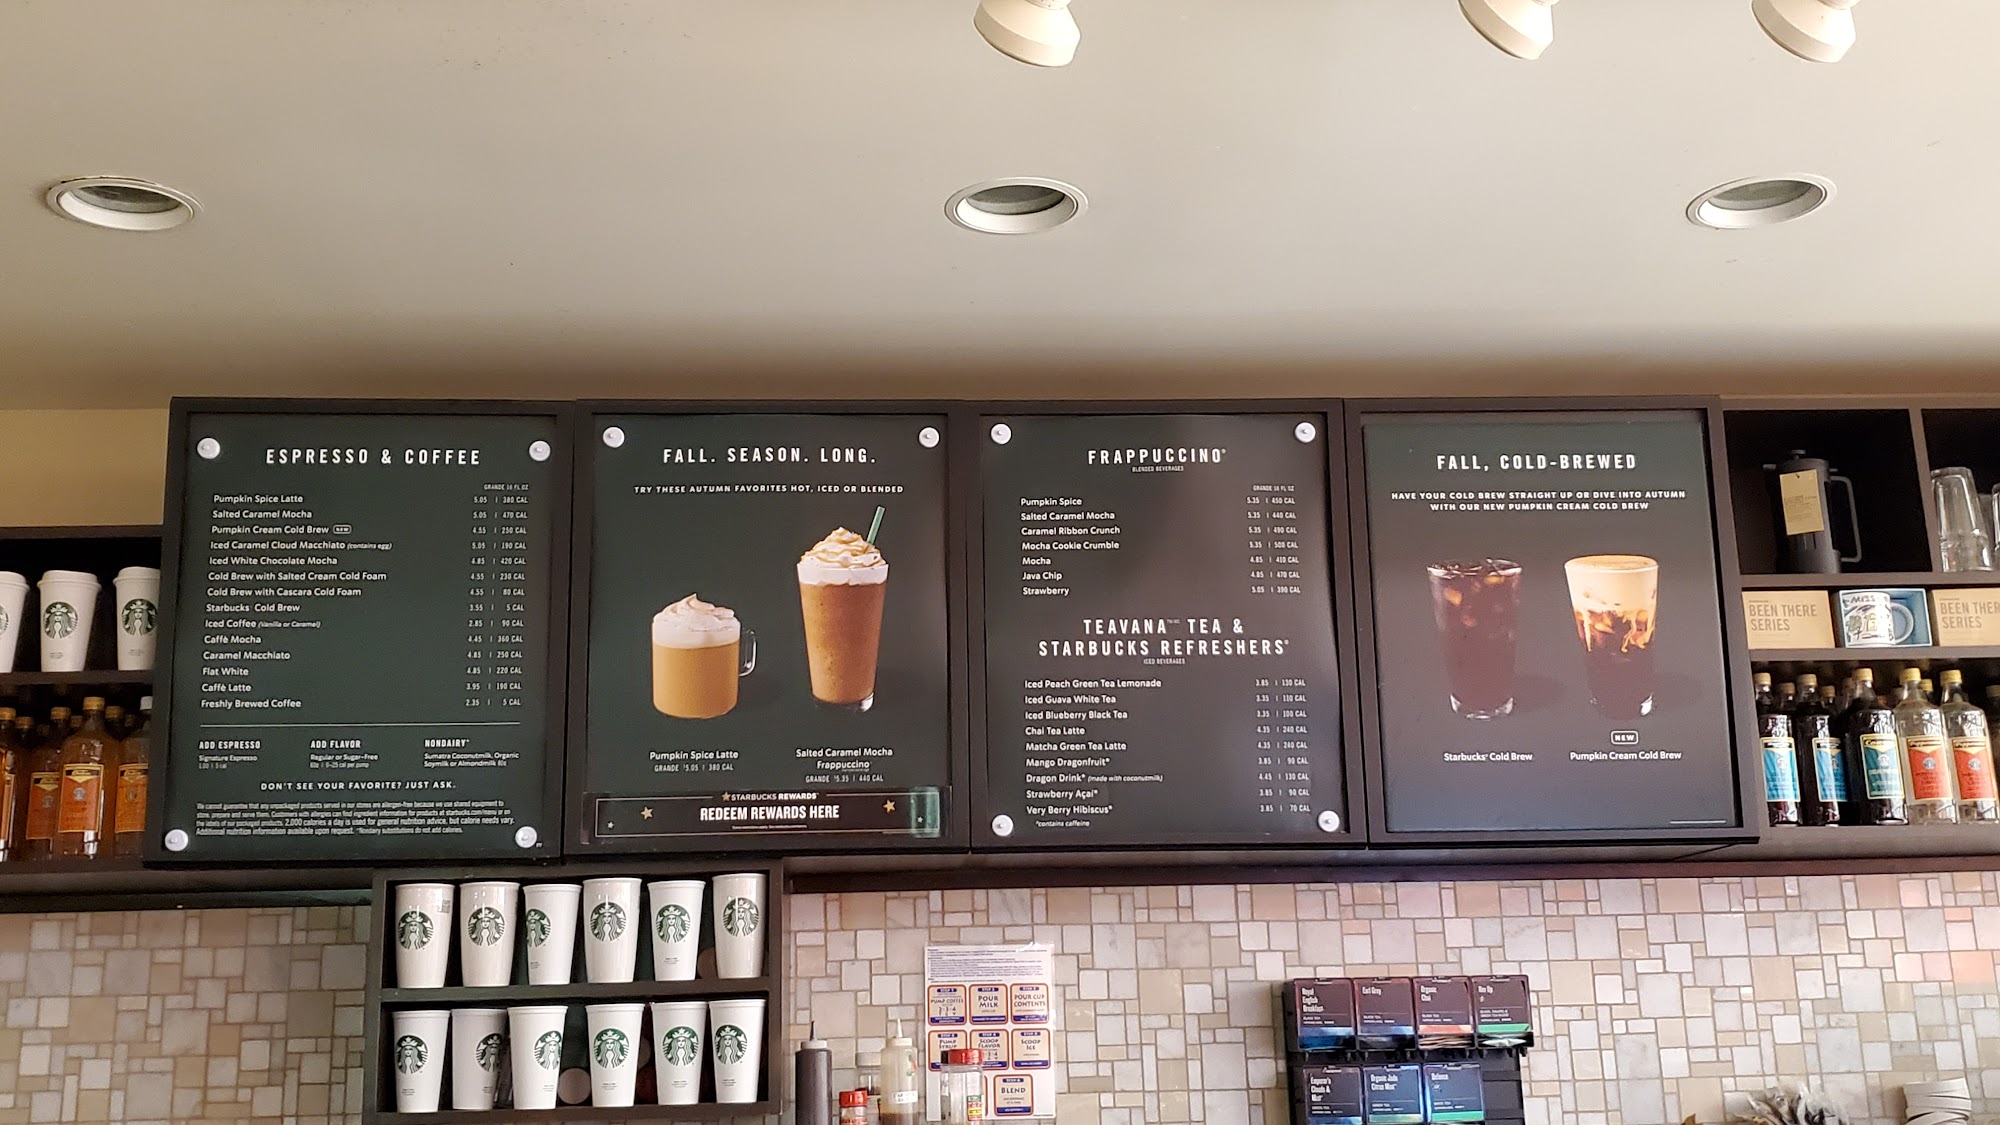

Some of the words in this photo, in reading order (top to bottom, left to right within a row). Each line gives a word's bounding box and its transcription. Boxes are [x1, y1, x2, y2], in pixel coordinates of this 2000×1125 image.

[266, 448, 367, 464] ESPRESSO
[381, 448, 391, 464] &
[405, 449, 479, 465] COFFEE
[663, 448, 715, 463] FALL.
[727, 447, 808, 462] SEASON.
[820, 447, 875, 463] LONG.
[1436, 455, 1488, 471] FALL,
[1499, 454, 1635, 469] COLD-BREWED
[655, 485, 685, 493] THESE
[734, 484, 786, 492] FAVORITES
[790, 484, 813, 492] HOT,
[817, 484, 839, 492] ICED
[213, 494, 252, 504] Pumpkin
[254, 494, 279, 504] Spice
[280, 494, 303, 502] Latte
[1477, 491, 1505, 499] BREW
[1508, 491, 1556, 499] STRAIGHT
[1644, 490, 1685, 498] AUTUMN
[1020, 497, 1057, 507] Pumpkin
[1059, 497, 1082, 506] Spice
[1246, 496, 1259, 504] 5.35
[1508, 502, 1553, 510] PUMPKIN
[1556, 502, 1589, 510] CREAM
[1020, 526, 1056, 535] Caramel
[1058, 526, 1088, 535] Ribbon
[1089, 525, 1120, 534] Crunch
[210, 540, 229, 549] Iced
[231, 540, 269, 549] Caramel
[270, 540, 297, 549] Cloud
[299, 540, 345, 549] Macchiato
[209, 556, 228, 565] Iced
[230, 556, 258, 564] White
[259, 556, 305, 565] Chocolate
[307, 556, 337, 564] Mocha
[1022, 556, 1051, 565] Mocha
[1022, 571, 1040, 580] Java
[1042, 571, 1062, 581] Chip
[1022, 586, 1069, 596] Strawberry
[1749, 604, 1778, 617] BEEN
[1780, 603, 1817, 618] THERE
[1940, 601, 1969, 615] BEEN
[204, 619, 224, 627] Iced
[226, 618, 256, 627] Coffee
[1187, 618, 1221, 634] TEA
[1232, 618, 1243, 633] &
[1750, 618, 1790, 631] SERIES
[1942, 615, 1982, 629] SERIES
[203, 634, 228, 643] Caffè
[230, 635, 261, 643] Mocha
[1038, 640, 1148, 656] STARBUCKS
[203, 650, 241, 659] Caramel
[243, 651, 290, 659] Macchiato
[202, 666, 219, 675] Flat
[220, 667, 249, 675] White
[201, 683, 226, 691] Caffè
[228, 683, 251, 692] Latte
[201, 699, 233, 709] Freshly
[234, 699, 269, 708] Brewed
[270, 698, 301, 707] Coffee
[1024, 695, 1043, 704] Iced
[1044, 695, 1072, 704] Guava
[1073, 694, 1100, 703] White
[1101, 694, 1116, 703] Tea
[1025, 710, 1043, 720] Iced
[1045, 710, 1087, 721] Blueberry
[1088, 710, 1111, 719] Black
[1112, 710, 1127, 719] Tea
[1025, 726, 1044, 735] Chai
[1046, 726, 1061, 735] Tea
[1063, 726, 1085, 735] Latte
[1614, 734, 1635, 742] NEW
[198, 740, 215, 749] ADD
[217, 740, 260, 749] ESPRESSO
[310, 740, 327, 748] ADD
[329, 739, 360, 748] FLAVOR
[649, 750, 688, 761] Pumpkin
[690, 750, 714, 760] Spice
[715, 750, 738, 759] Latte
[796, 748, 823, 758] Salted
[824, 747, 861, 758] Caramel
[863, 747, 893, 756] Mocha
[1488, 752, 1509, 761] Cold
[1510, 752, 1532, 760] Brew
[1570, 751, 1608, 761] Pumpkin
[1608, 751, 1637, 760] Cream
[1638, 750, 1658, 760] Cold
[1659, 750, 1681, 759] Brew
[654, 764, 679, 772] GRANDE
[708, 763, 720, 771] 380
[721, 763, 733, 771] CAL
[1025, 758, 1055, 768] Mango
[1026, 773, 1056, 784] Dragon
[296, 782, 313, 790] SEE
[348, 781, 401, 789] FAVORITE?
[404, 781, 429, 789] JUST
[731, 793, 776, 801] STARBUCKS
[1026, 789, 1073, 800] Strawberry
[699, 806, 747, 821] REDEEM
[750, 805, 806, 820] REWARDS
[809, 804, 839, 818] HERE
[1026, 805, 1046, 816] Very
[1048, 805, 1071, 815] Berry
